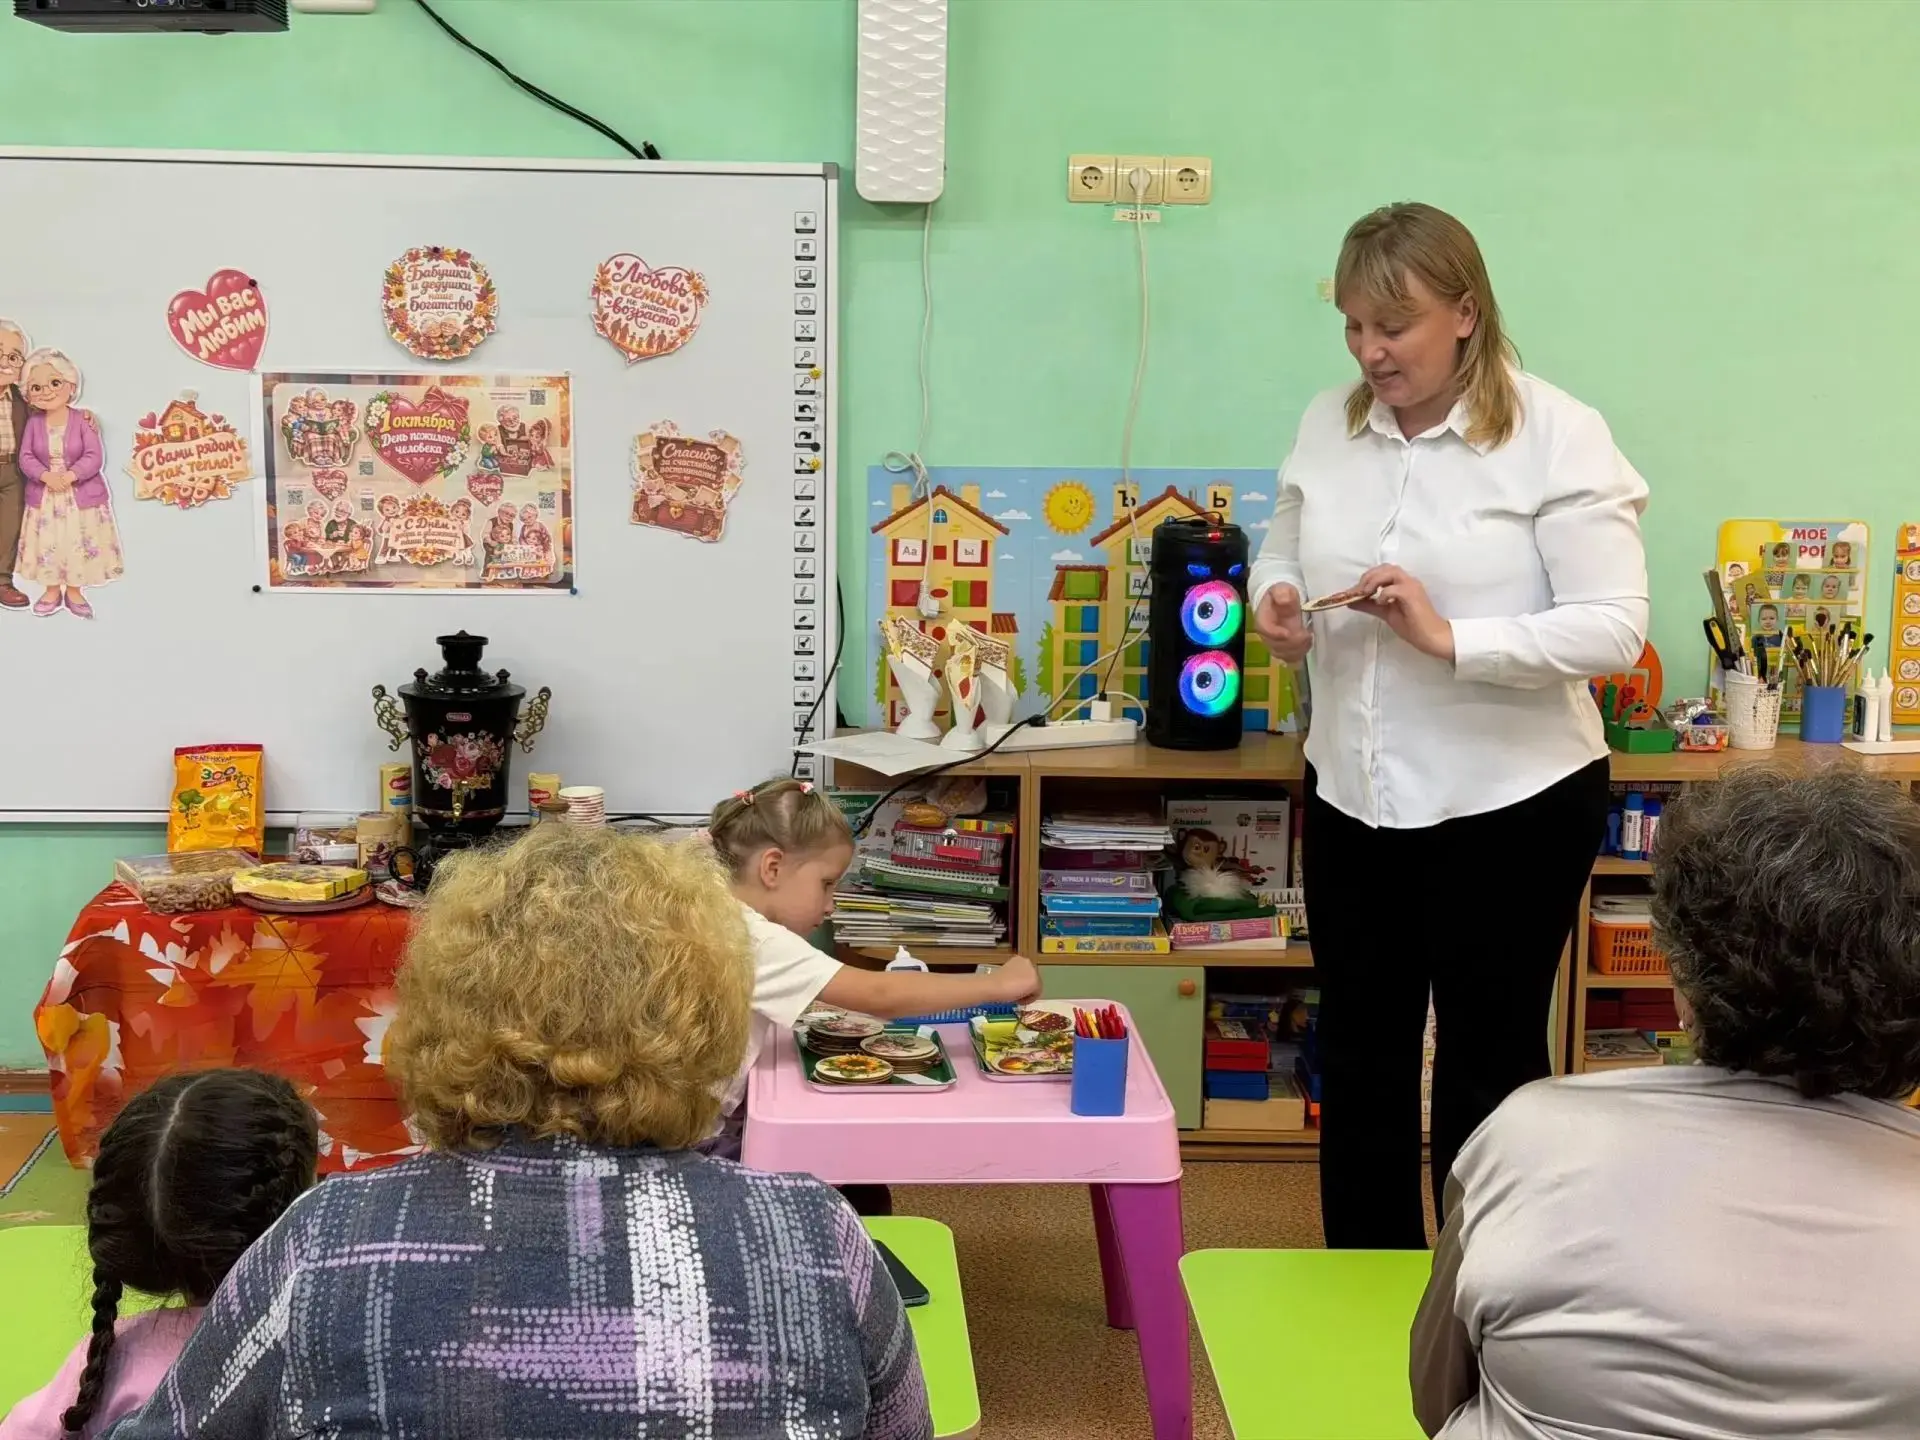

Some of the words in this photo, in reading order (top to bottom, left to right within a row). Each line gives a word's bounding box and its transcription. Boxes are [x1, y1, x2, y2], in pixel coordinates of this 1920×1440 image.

[406, 263, 472, 282] Бабушки
[612, 262, 688, 297] Любовь
[409, 296, 473, 312] богатство
[620, 283, 680, 312] семьи
[605, 297, 680, 328] возраста
[640, 303, 669, 314] знает
[380, 410, 391, 432] 1
[392, 413, 456, 432] октября
[381, 433, 408, 448] День
[409, 432, 456, 445] пожилого
[395, 442, 443, 455] человека
[141, 450, 155, 471] С
[156, 447, 194, 466] вами
[196, 438, 237, 459] рядом
[662, 443, 721, 462] Спасибо
[155, 463, 186, 482] так
[187, 453, 234, 473] тепло!
[660, 459, 670, 467] за
[672, 459, 717, 472] счастливые
[1213, 491, 1227, 507] Ь
